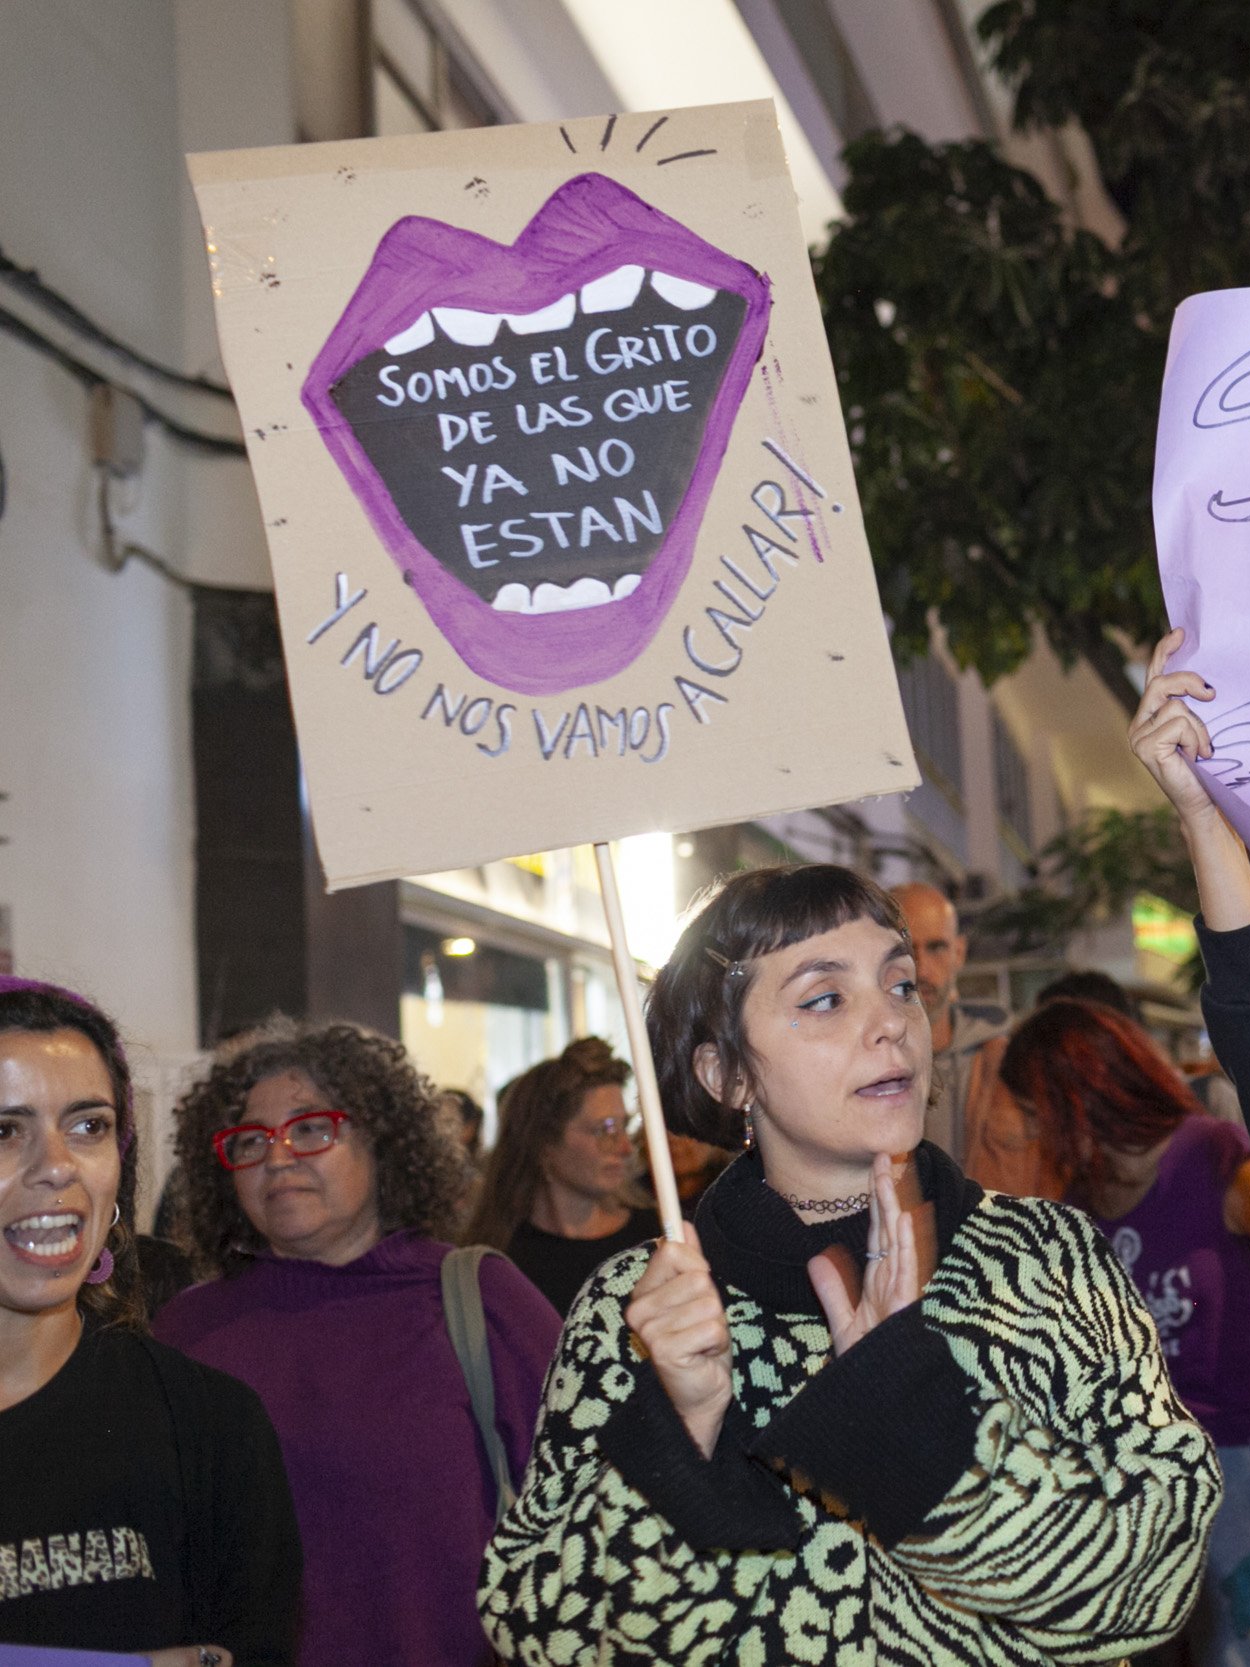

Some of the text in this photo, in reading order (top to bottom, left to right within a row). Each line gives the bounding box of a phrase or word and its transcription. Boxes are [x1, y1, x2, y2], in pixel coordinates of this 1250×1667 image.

[376, 323, 717, 407] SOMOS EL GRiTO
[437, 379, 692, 452] DE LAS QUE
[441, 438, 636, 508] YA NO
[460, 489, 664, 569] ESTAN
[306, 436, 845, 764] Y NO NOS VAMOS A CALLAR!
